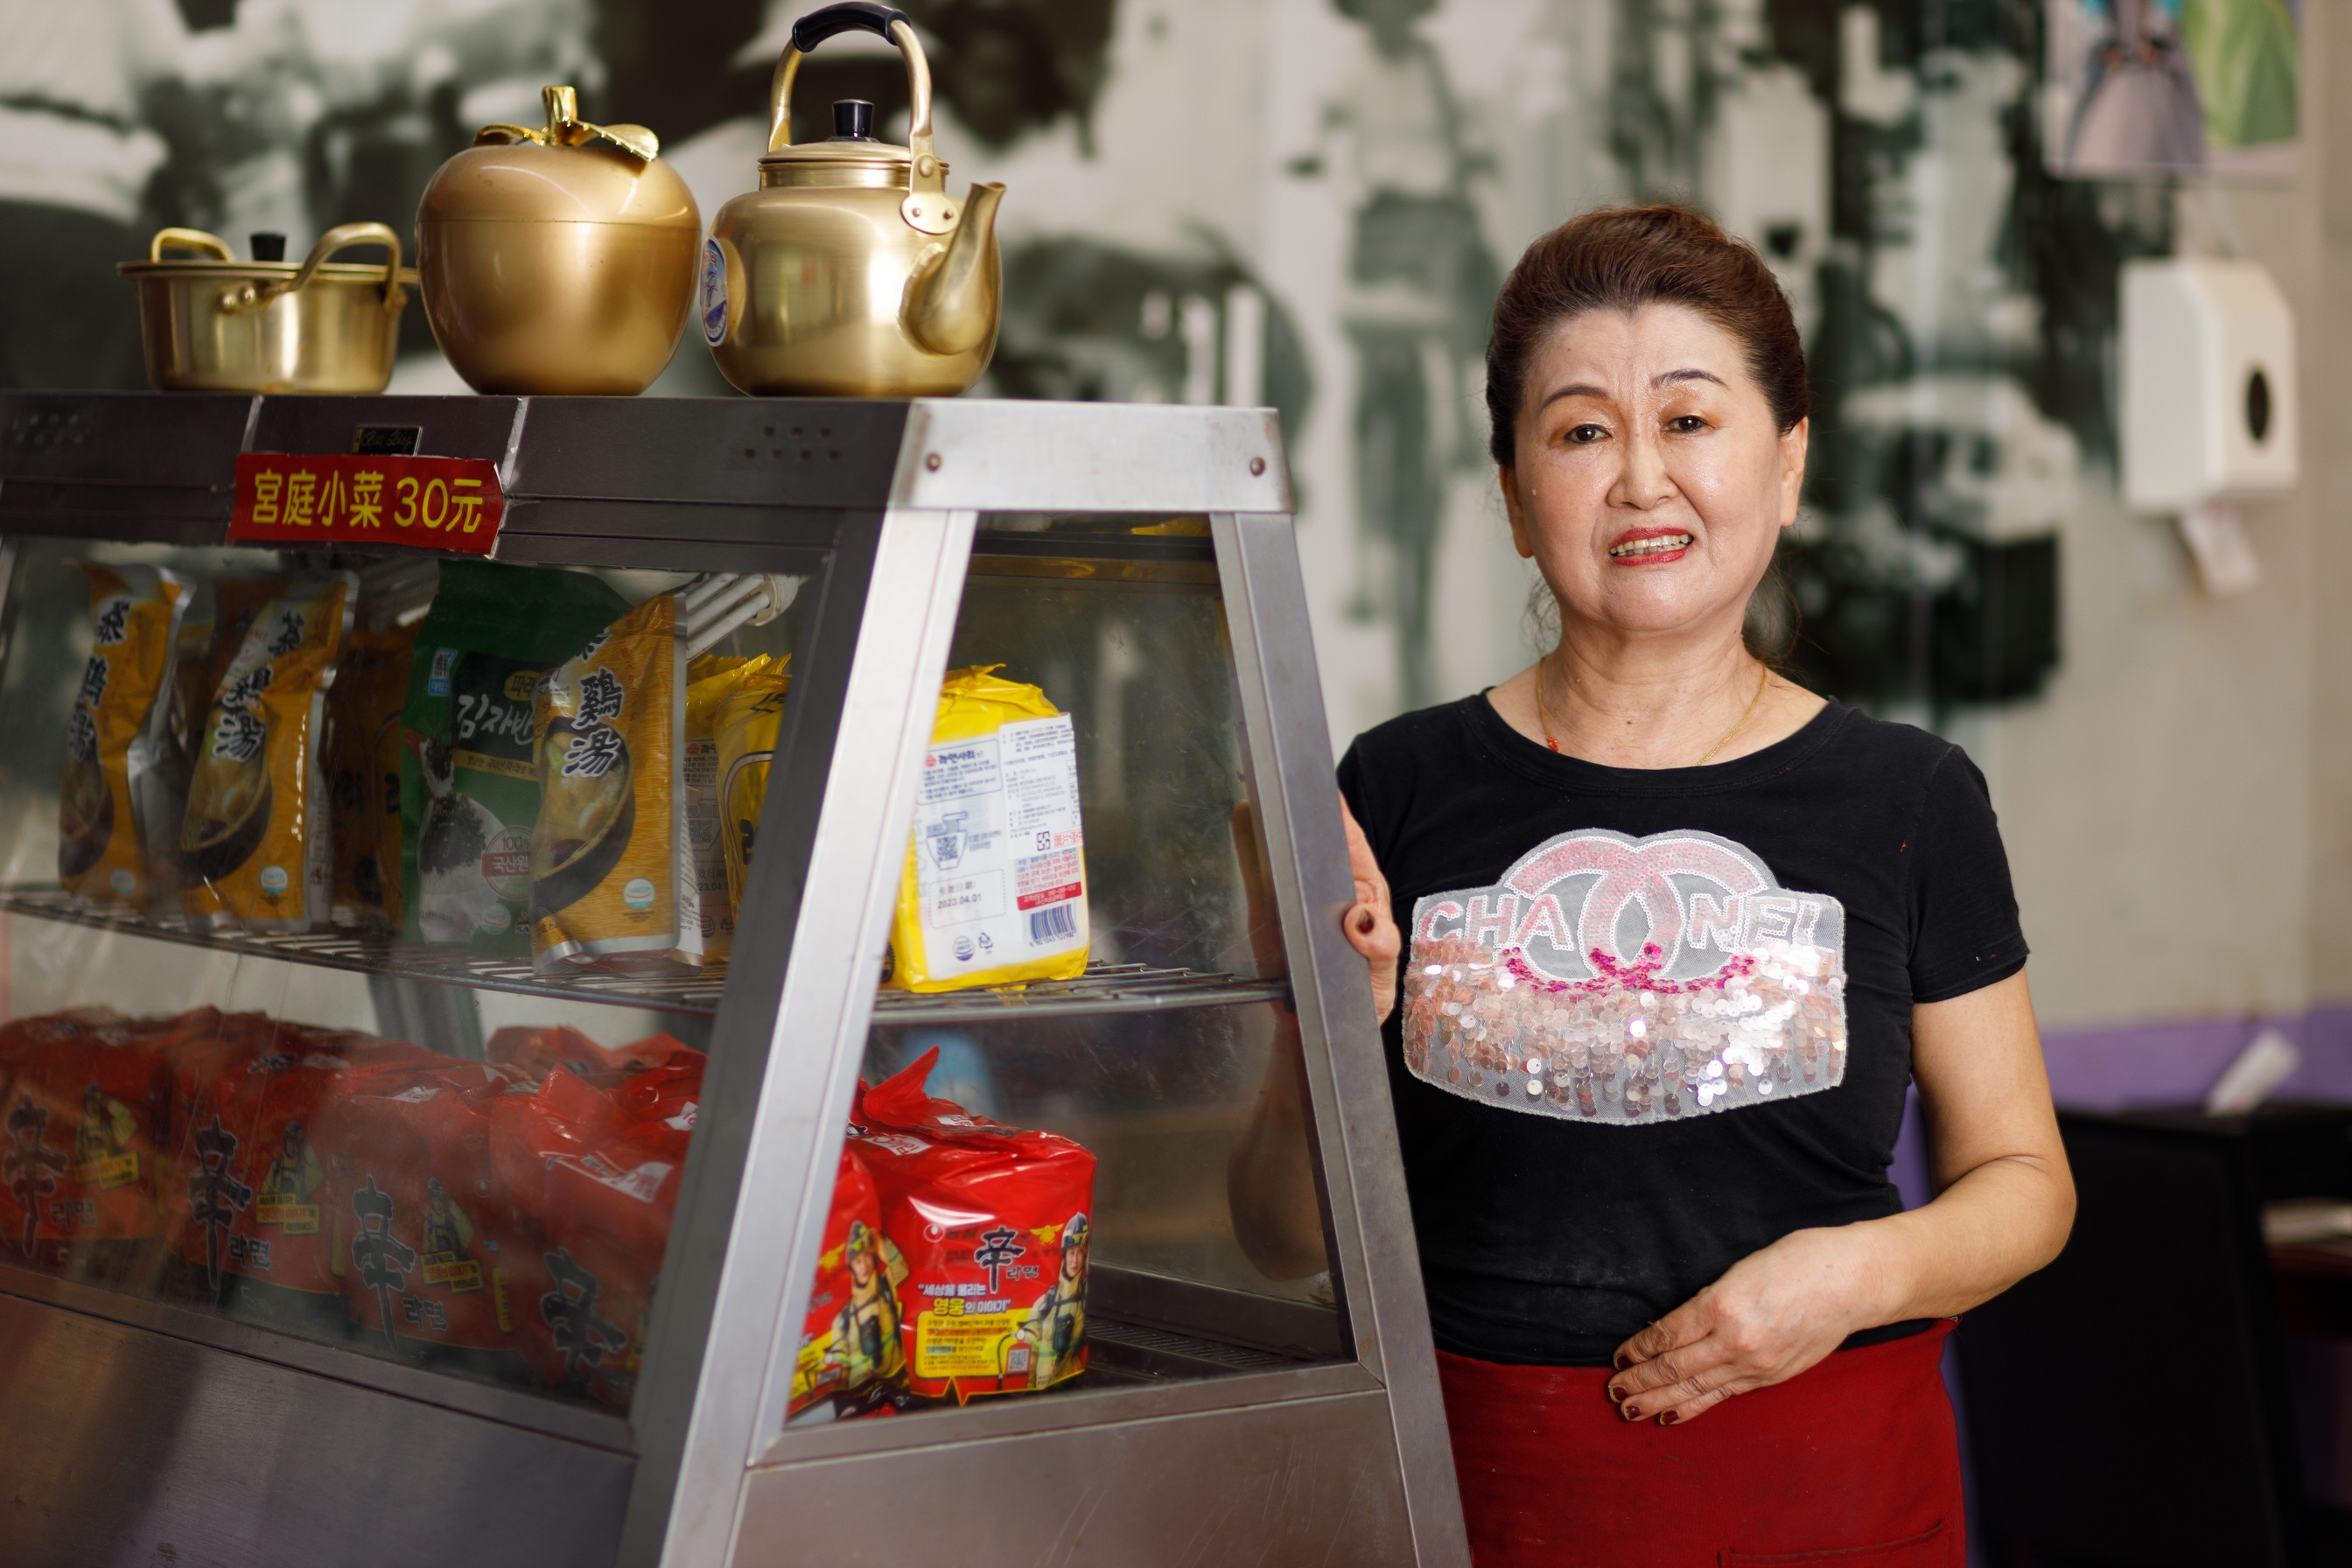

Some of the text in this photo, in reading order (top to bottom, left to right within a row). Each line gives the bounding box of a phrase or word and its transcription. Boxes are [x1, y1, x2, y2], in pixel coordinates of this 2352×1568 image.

[252, 467, 483, 533] 宮庭小菜 30元
[937, 893, 982, 909] 2023.04.01
[189, 1115, 252, 1292] 辛
[229, 1235, 273, 1270] 라면
[353, 1174, 416, 1353] 辛
[973, 1225, 1026, 1295] 辛
[1006, 1265, 1040, 1283] 라면
[402, 1295, 449, 1333] 라면
[933, 1298, 976, 1317] 영웅의
